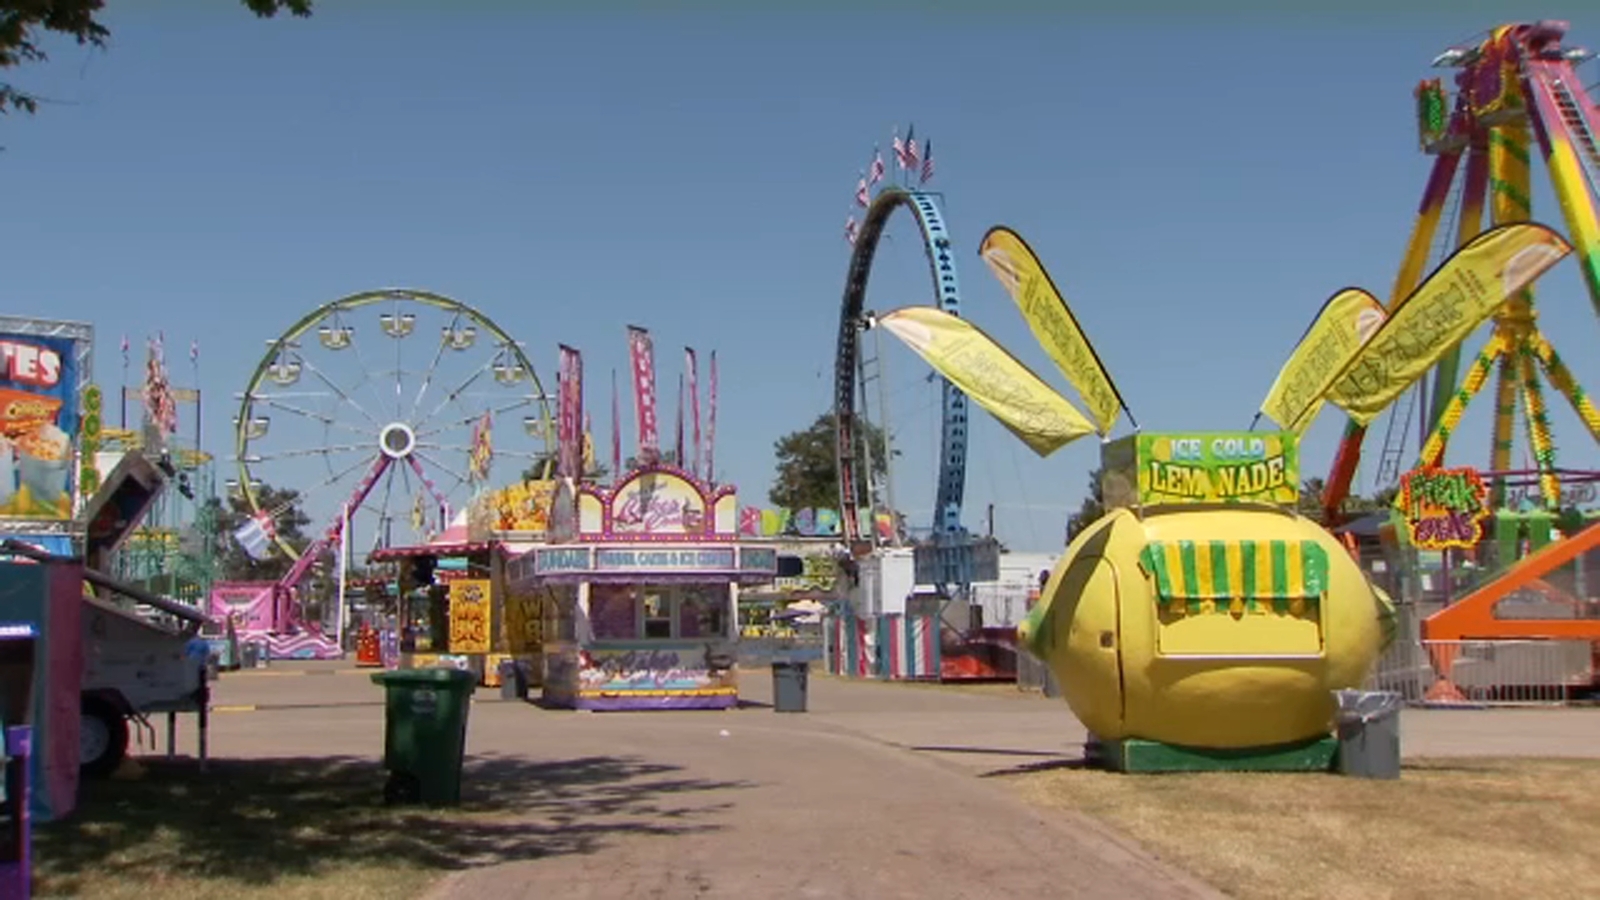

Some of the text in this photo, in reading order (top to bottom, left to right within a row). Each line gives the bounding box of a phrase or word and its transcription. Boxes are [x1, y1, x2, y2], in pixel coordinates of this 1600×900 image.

[1170, 437, 1266, 461] ICE COLD
[1150, 455, 1285, 498] LEMNADE
